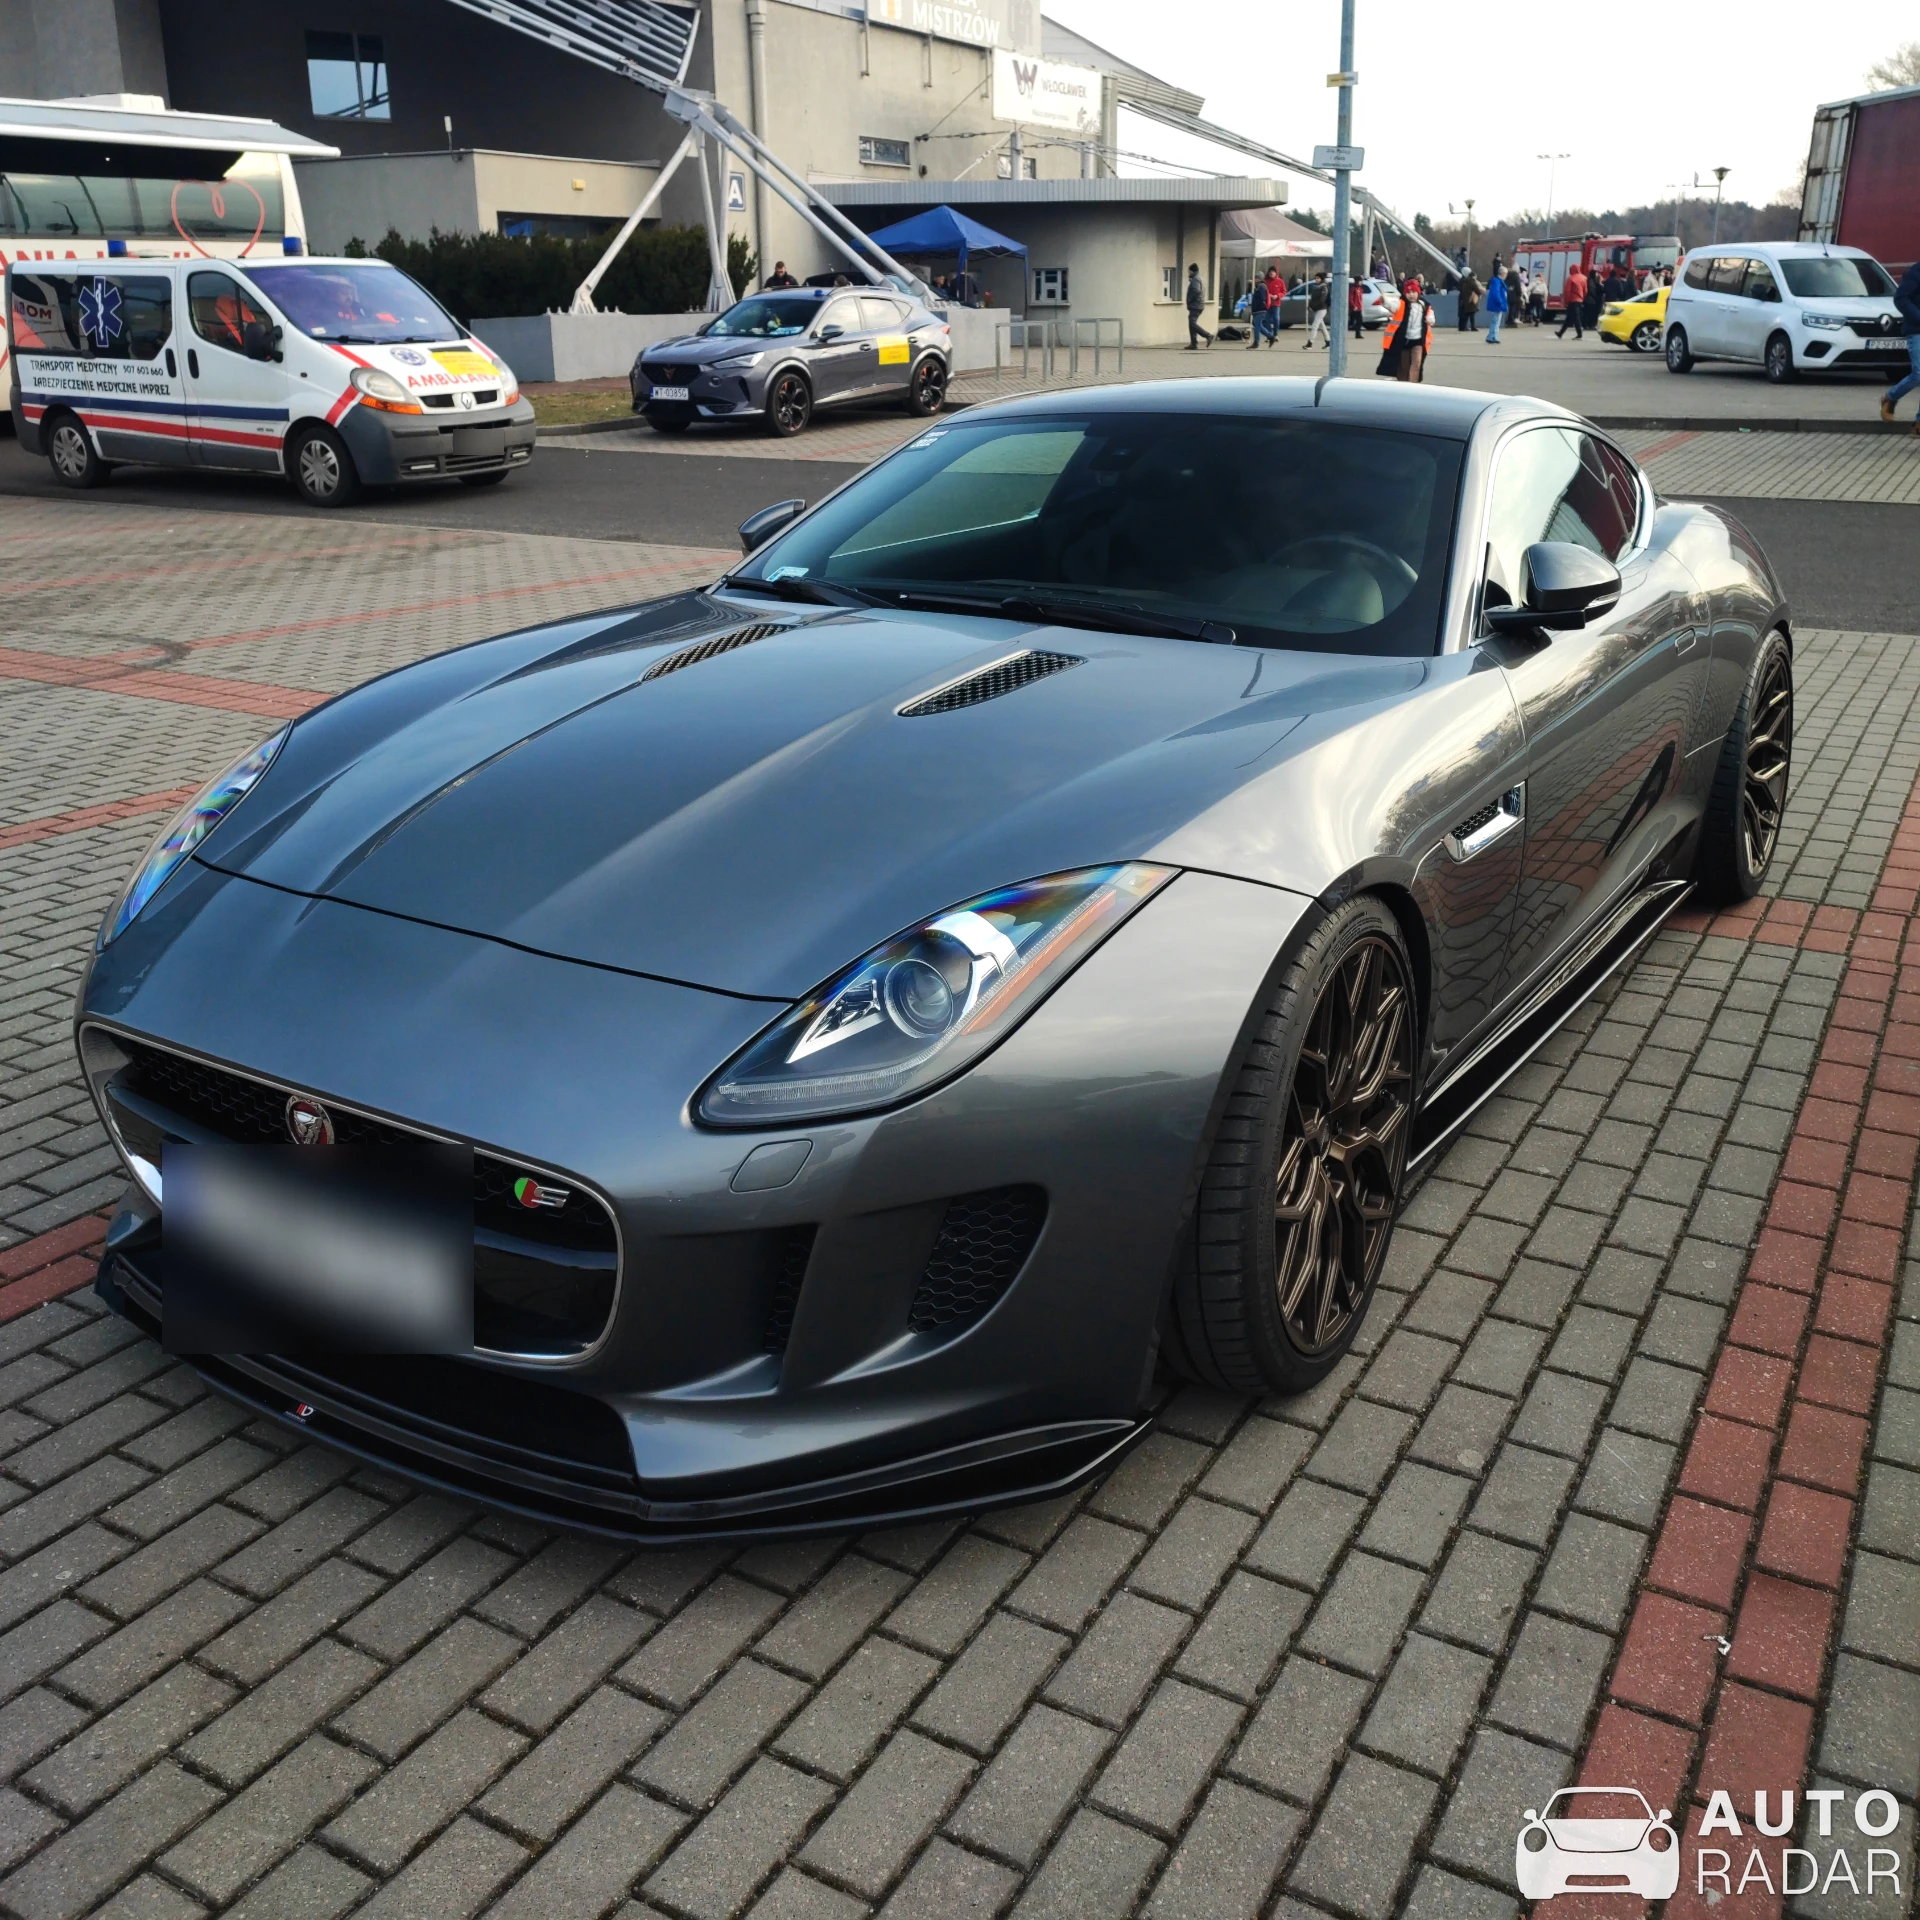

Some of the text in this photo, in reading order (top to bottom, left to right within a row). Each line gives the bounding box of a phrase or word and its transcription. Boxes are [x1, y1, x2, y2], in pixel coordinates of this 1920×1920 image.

[912, 2, 1001, 45] MISTRZÓW
[729, 179, 743, 205] A
[30, 360, 74, 372] TRANSPORT
[77, 360, 117, 375] MEDYCZNY
[33, 377, 171, 396] ZABEZPIECZENIE MEDYCZNE IMPREZ
